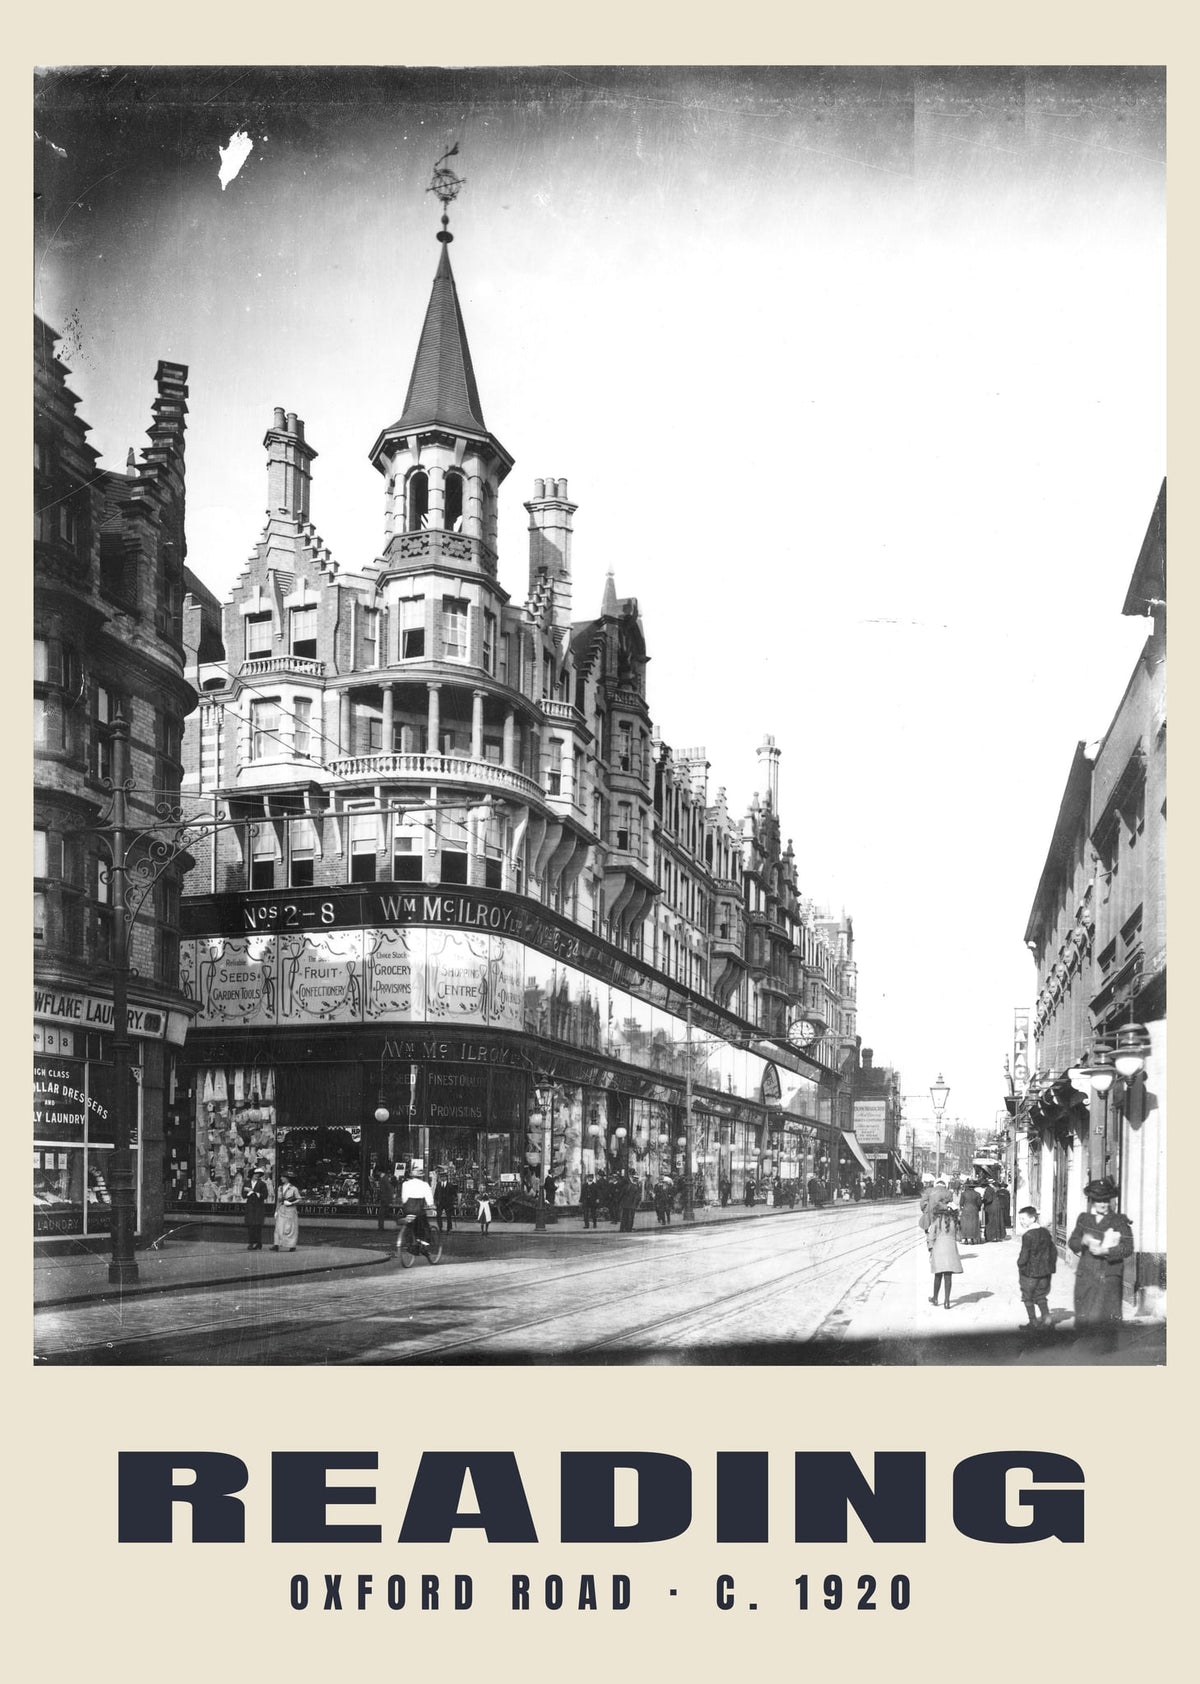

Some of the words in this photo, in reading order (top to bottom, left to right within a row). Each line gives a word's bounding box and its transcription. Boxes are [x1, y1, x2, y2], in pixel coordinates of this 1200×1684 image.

[304, 966, 339, 980] FRUIT
[375, 963, 411, 976] GROCERY
[213, 988, 240, 1001] GARDEN
[299, 983, 347, 1001] CONFECTIONERY
[437, 981, 478, 1000] CENTRE
[86, 999, 143, 1030] LAURY.
[48, 1069, 70, 1079] CLASS
[62, 1085, 109, 1120] DRESSERS
[45, 1112, 85, 1125] LAUNDRY
[299, 1206, 337, 1214] IMITED
